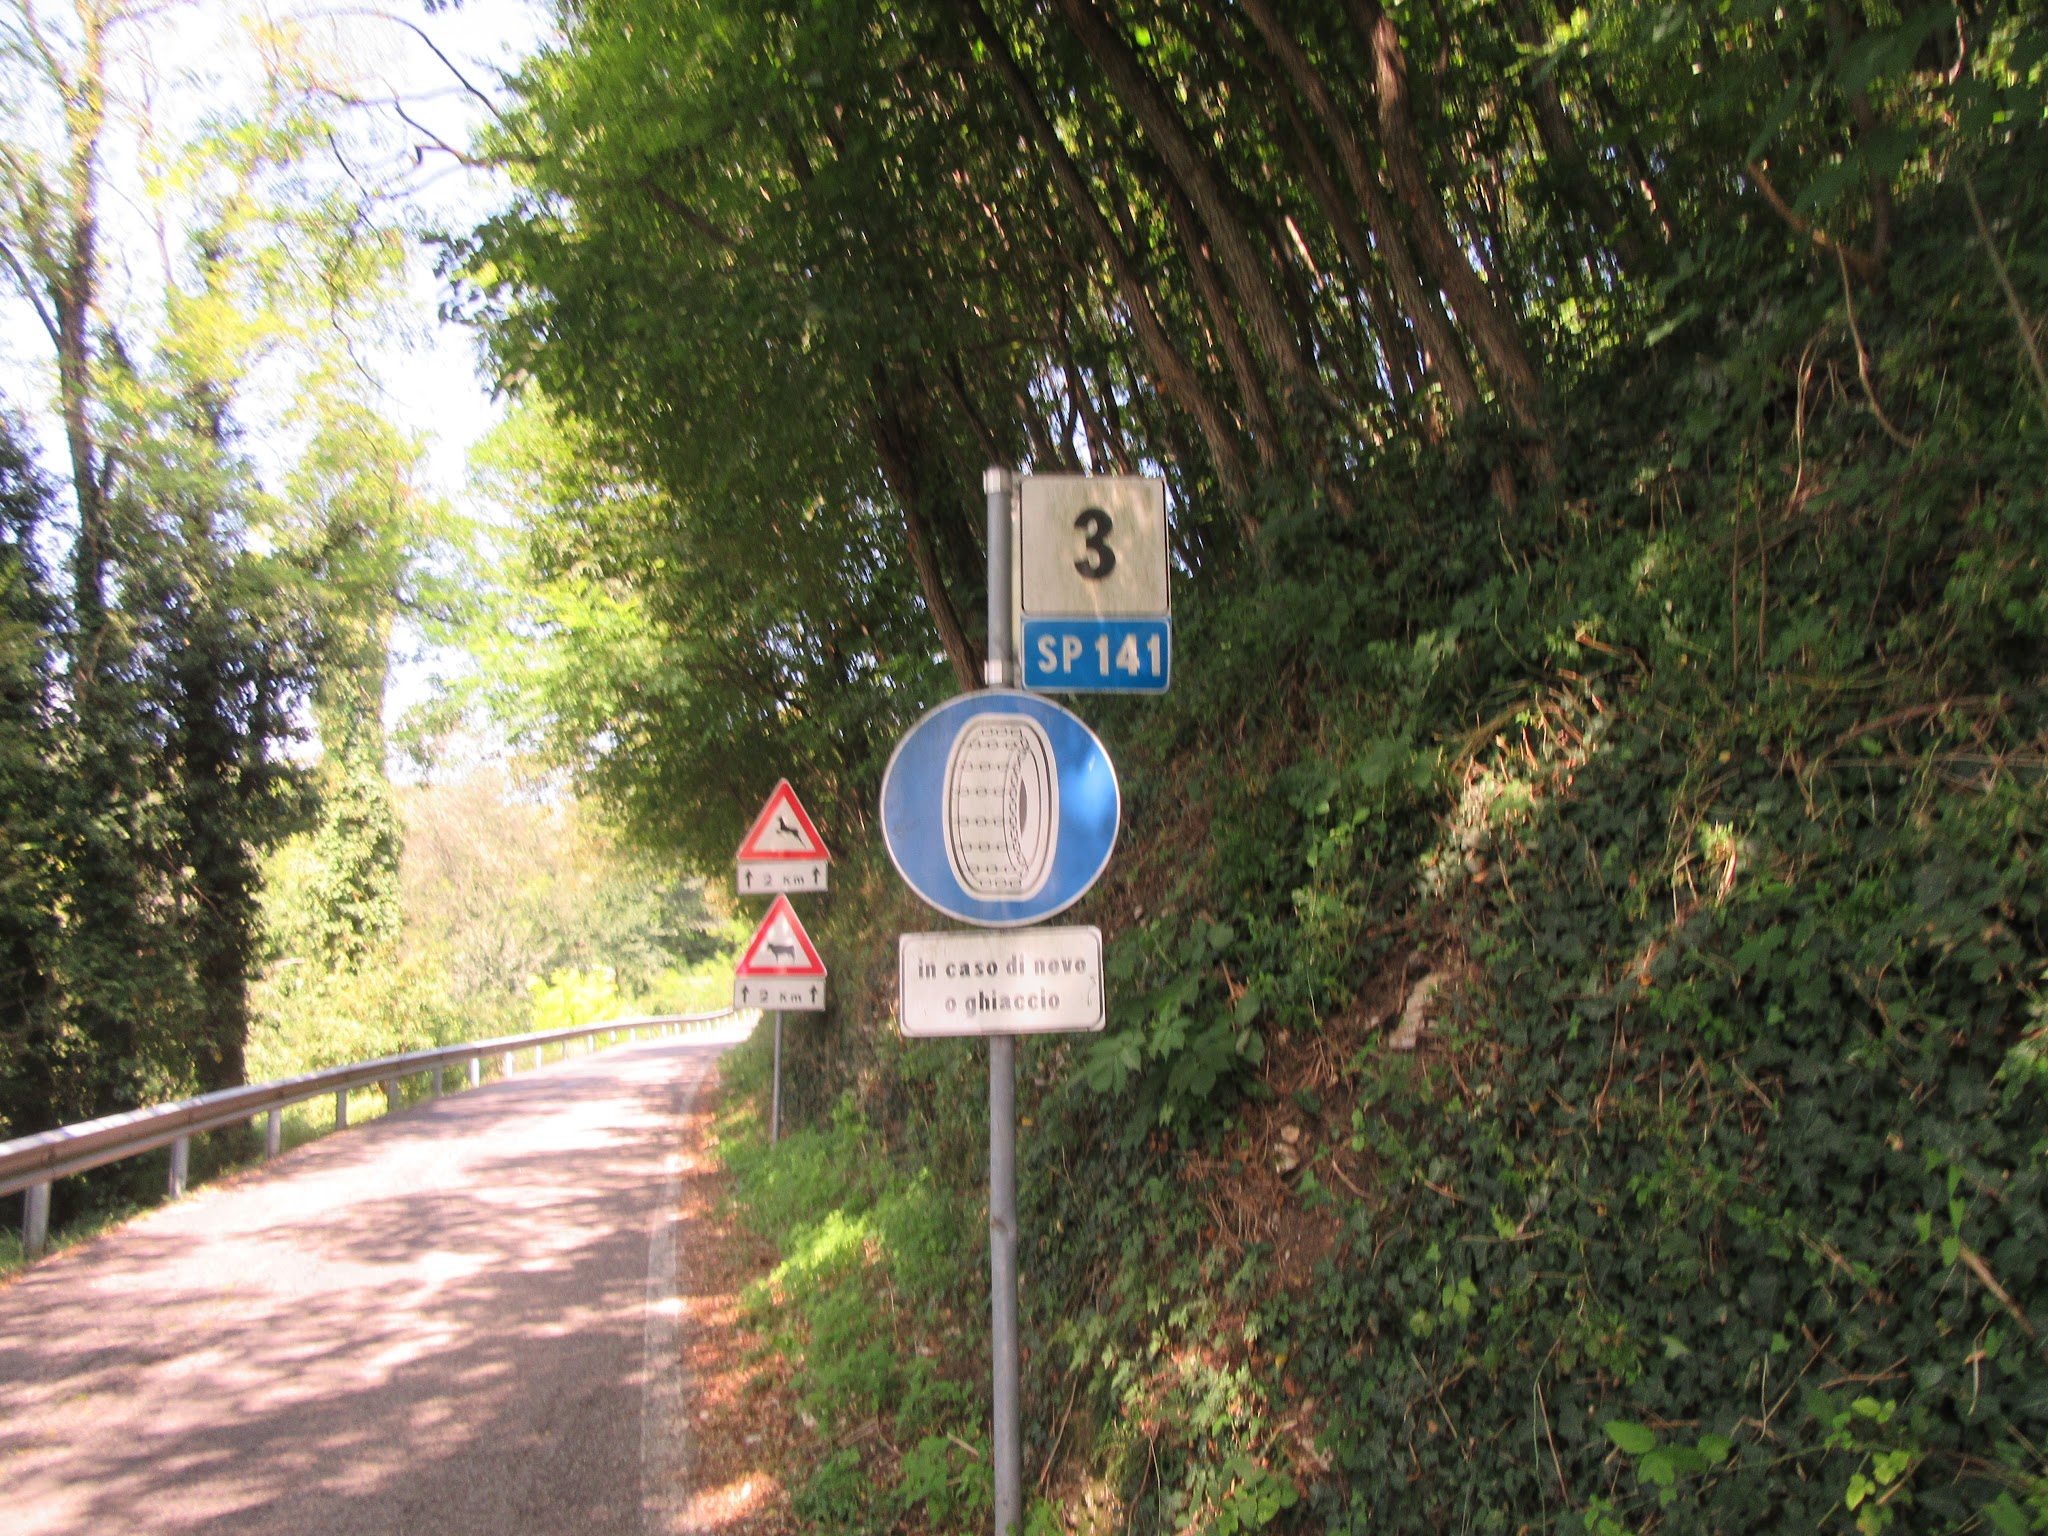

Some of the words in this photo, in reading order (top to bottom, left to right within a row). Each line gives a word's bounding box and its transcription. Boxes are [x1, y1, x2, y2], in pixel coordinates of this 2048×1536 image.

[1073, 508, 1116, 579] 3
[1037, 633, 1083, 673] SP
[1094, 633, 1161, 677] 141
[918, 958, 937, 980] in
[945, 960, 998, 978] caso
[1006, 953, 1025, 976] di
[945, 997, 957, 1013] o
[965, 987, 1060, 1017] ghiaccio
